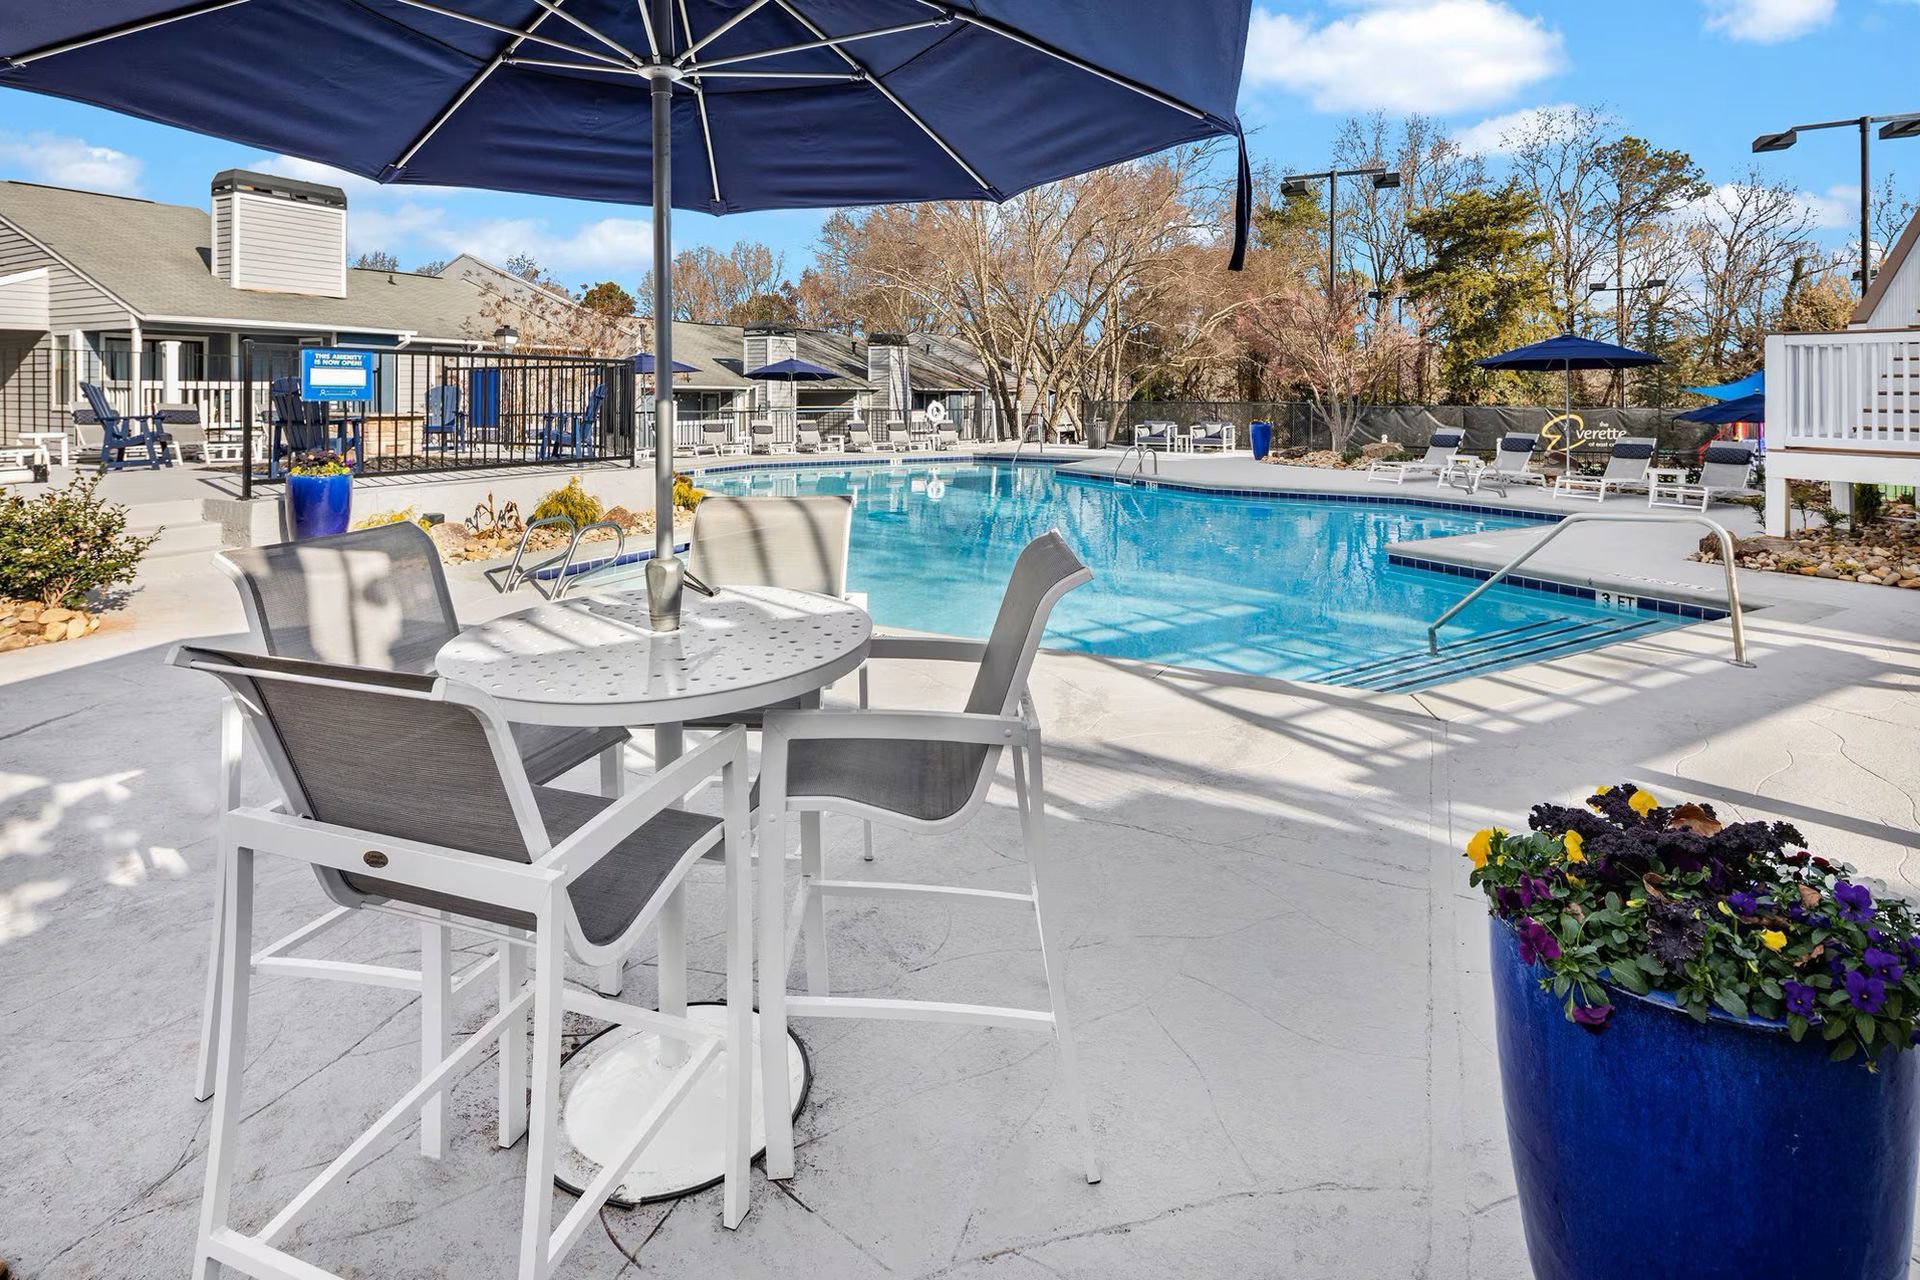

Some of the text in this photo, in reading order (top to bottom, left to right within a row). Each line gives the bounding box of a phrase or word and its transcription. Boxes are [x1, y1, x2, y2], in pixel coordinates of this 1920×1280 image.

[331, 353, 363, 361] AMENITY
[1601, 592, 1635, 606] 3 FT
